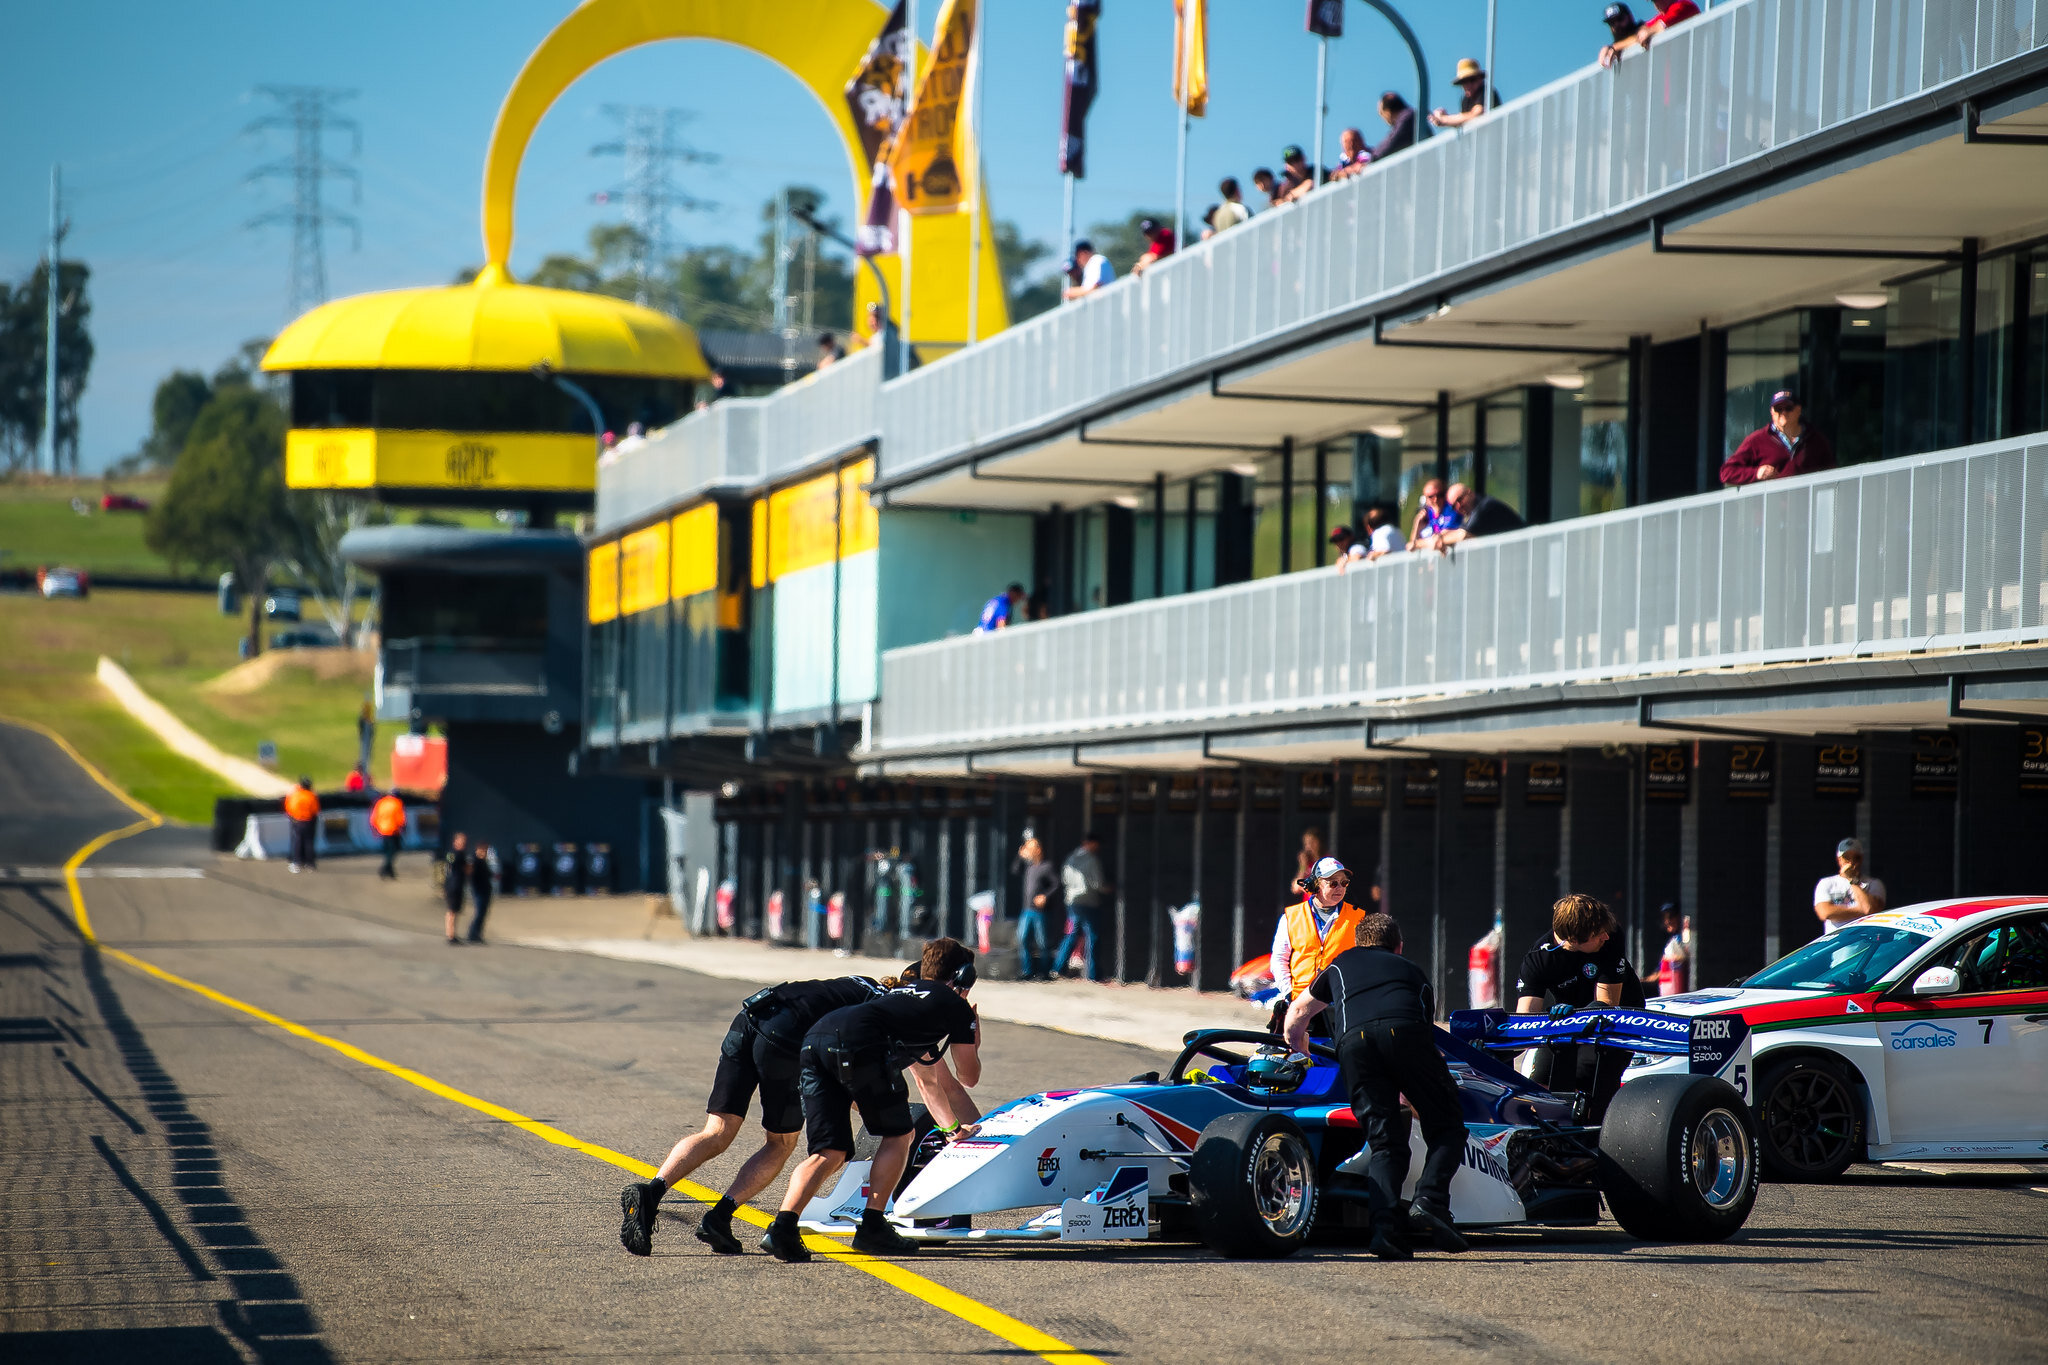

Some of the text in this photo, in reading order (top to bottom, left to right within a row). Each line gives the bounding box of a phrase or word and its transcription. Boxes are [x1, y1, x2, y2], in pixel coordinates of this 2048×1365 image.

[2024, 730, 2048, 758] 3
[1648, 747, 1685, 773] 26
[1730, 744, 1766, 770] 27
[1496, 1019, 1551, 1031] GARRY
[1692, 1019, 1731, 1040] ZEREX
[1977, 1018, 1994, 1045] 7
[1891, 1033, 1956, 1051] carsales
[1734, 1064, 1748, 1100] 5
[1036, 1157, 1061, 1172] ZEREX
[1103, 1206, 1146, 1229] ZEREX
